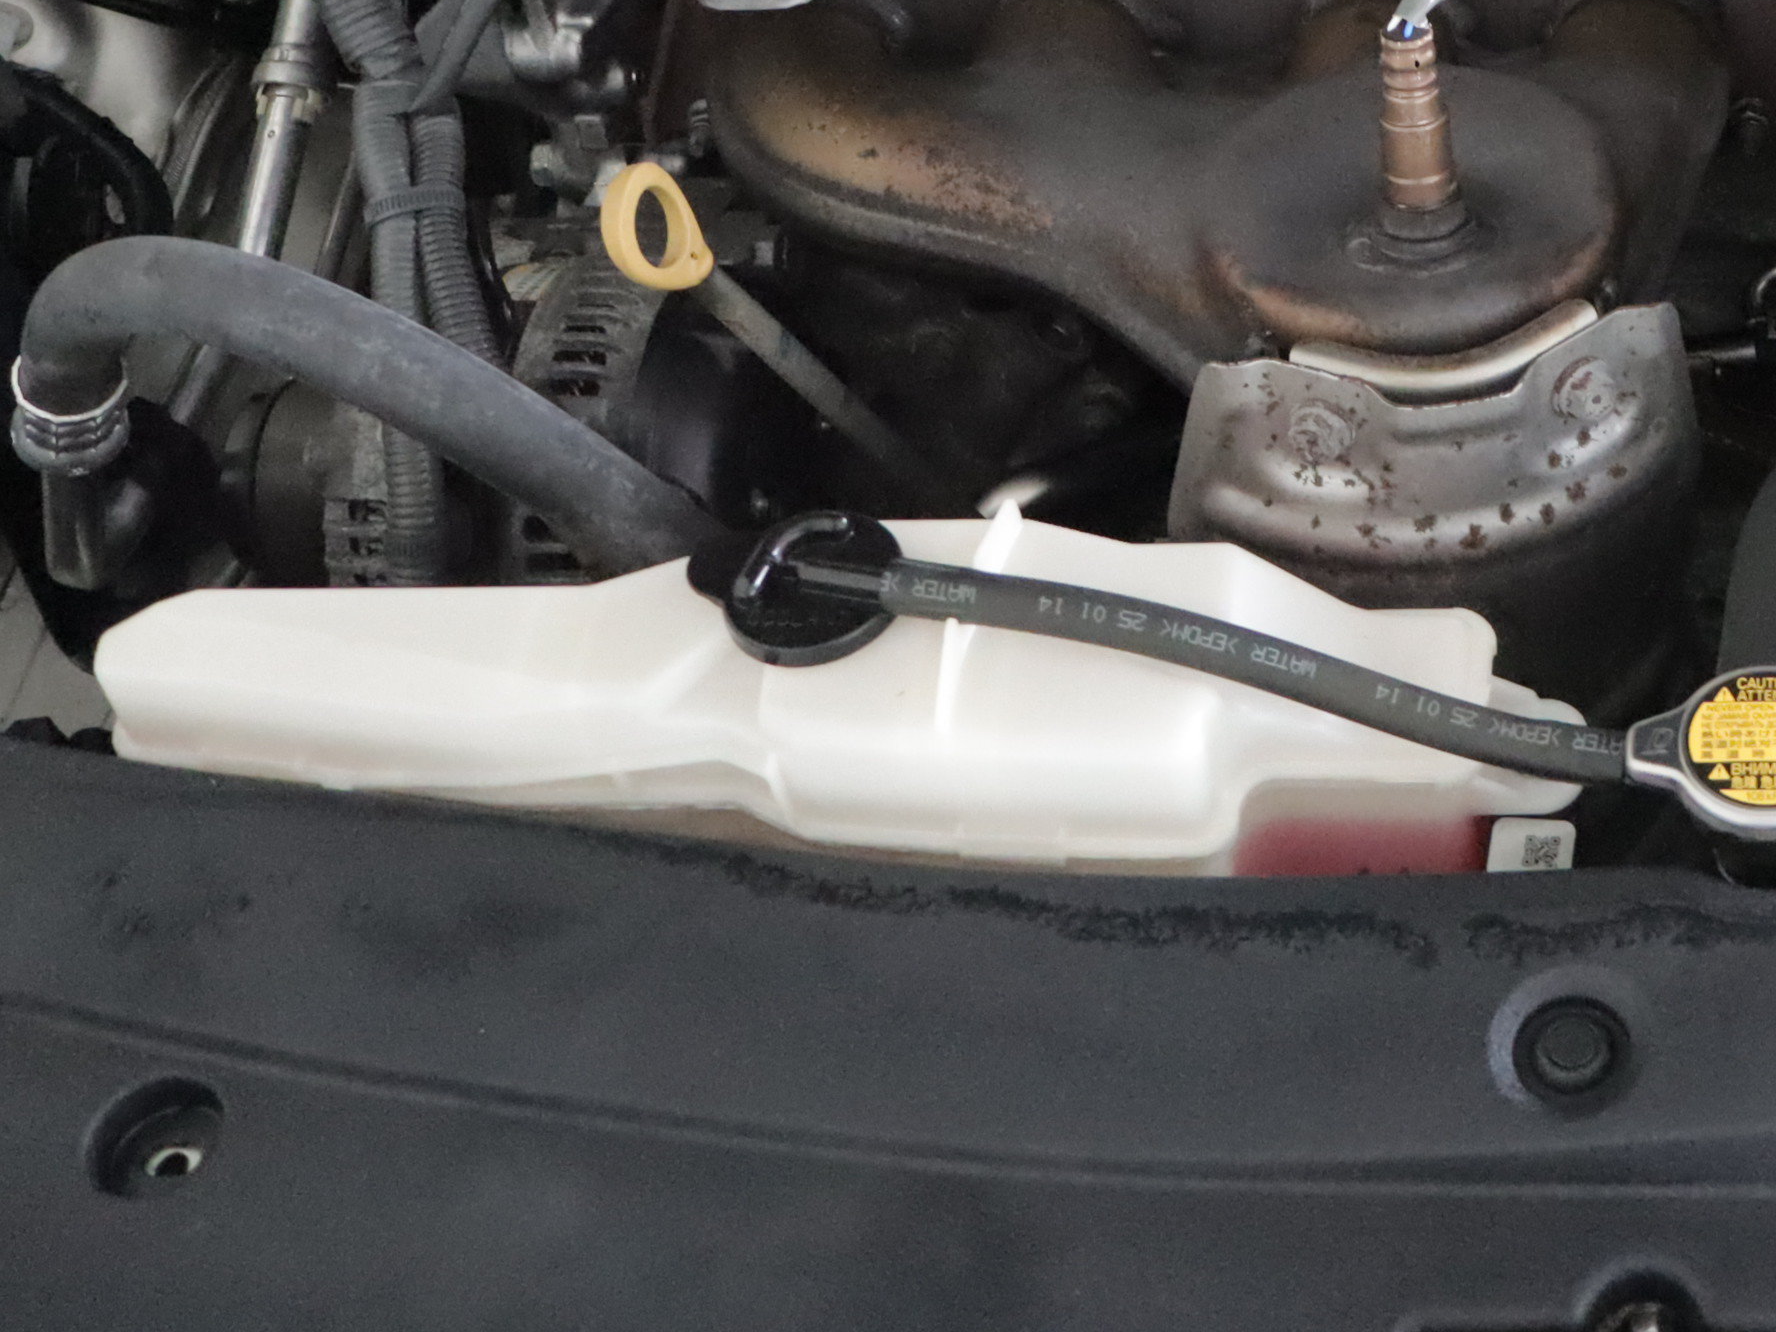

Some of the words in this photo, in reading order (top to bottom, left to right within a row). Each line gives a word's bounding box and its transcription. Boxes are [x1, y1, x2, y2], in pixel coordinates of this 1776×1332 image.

[911, 577, 977, 604] WATER
[1249, 642, 1318, 679] WATER
[1745, 703, 1774, 711] OPEN
[1573, 731, 1624, 757] ATER
